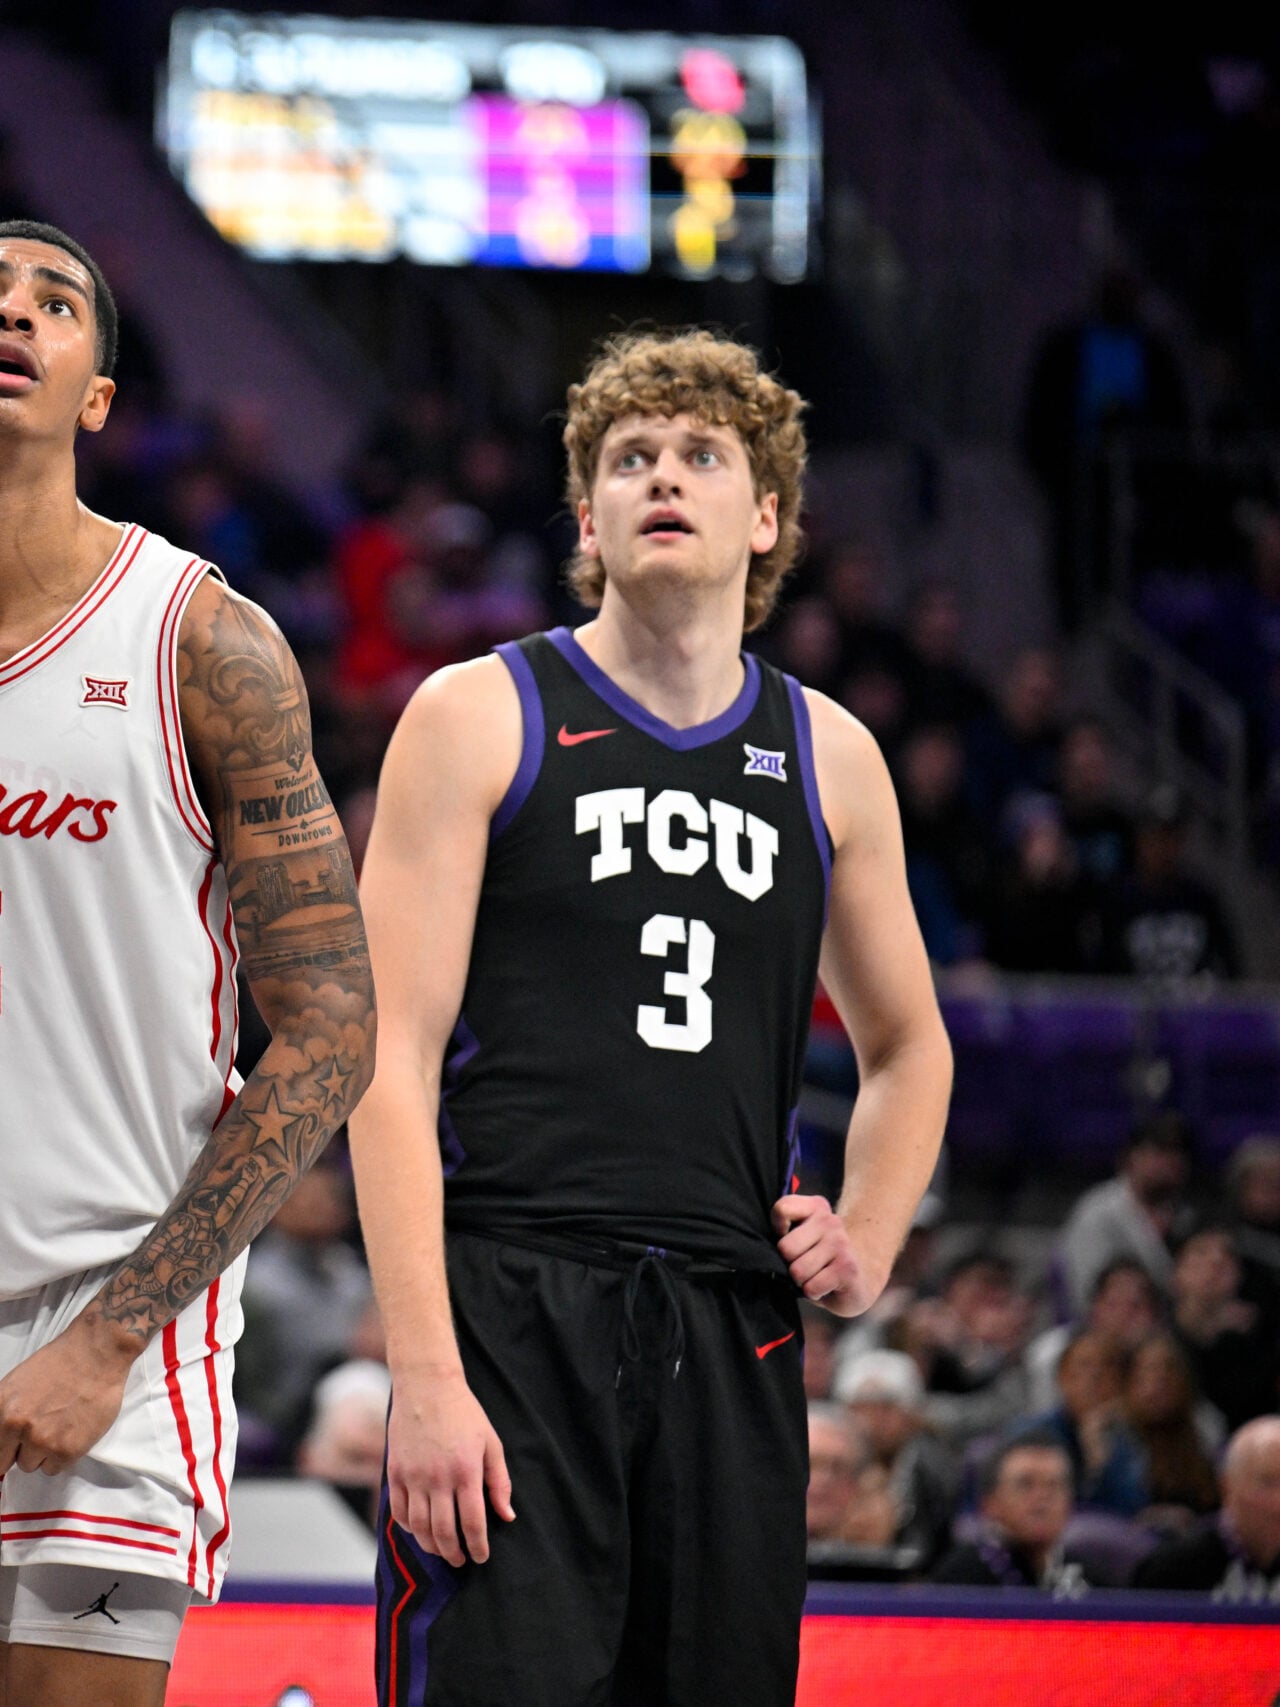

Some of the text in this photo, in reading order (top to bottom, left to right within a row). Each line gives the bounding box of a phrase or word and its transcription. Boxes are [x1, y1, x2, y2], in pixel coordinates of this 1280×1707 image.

[84, 679, 126, 705] XII
[746, 746, 785, 780] XII
[240, 795, 284, 826] NEW
[278, 825, 333, 848] DOWNTOWN
[575, 787, 779, 902] TCU
[636, 913, 716, 1053] 3
